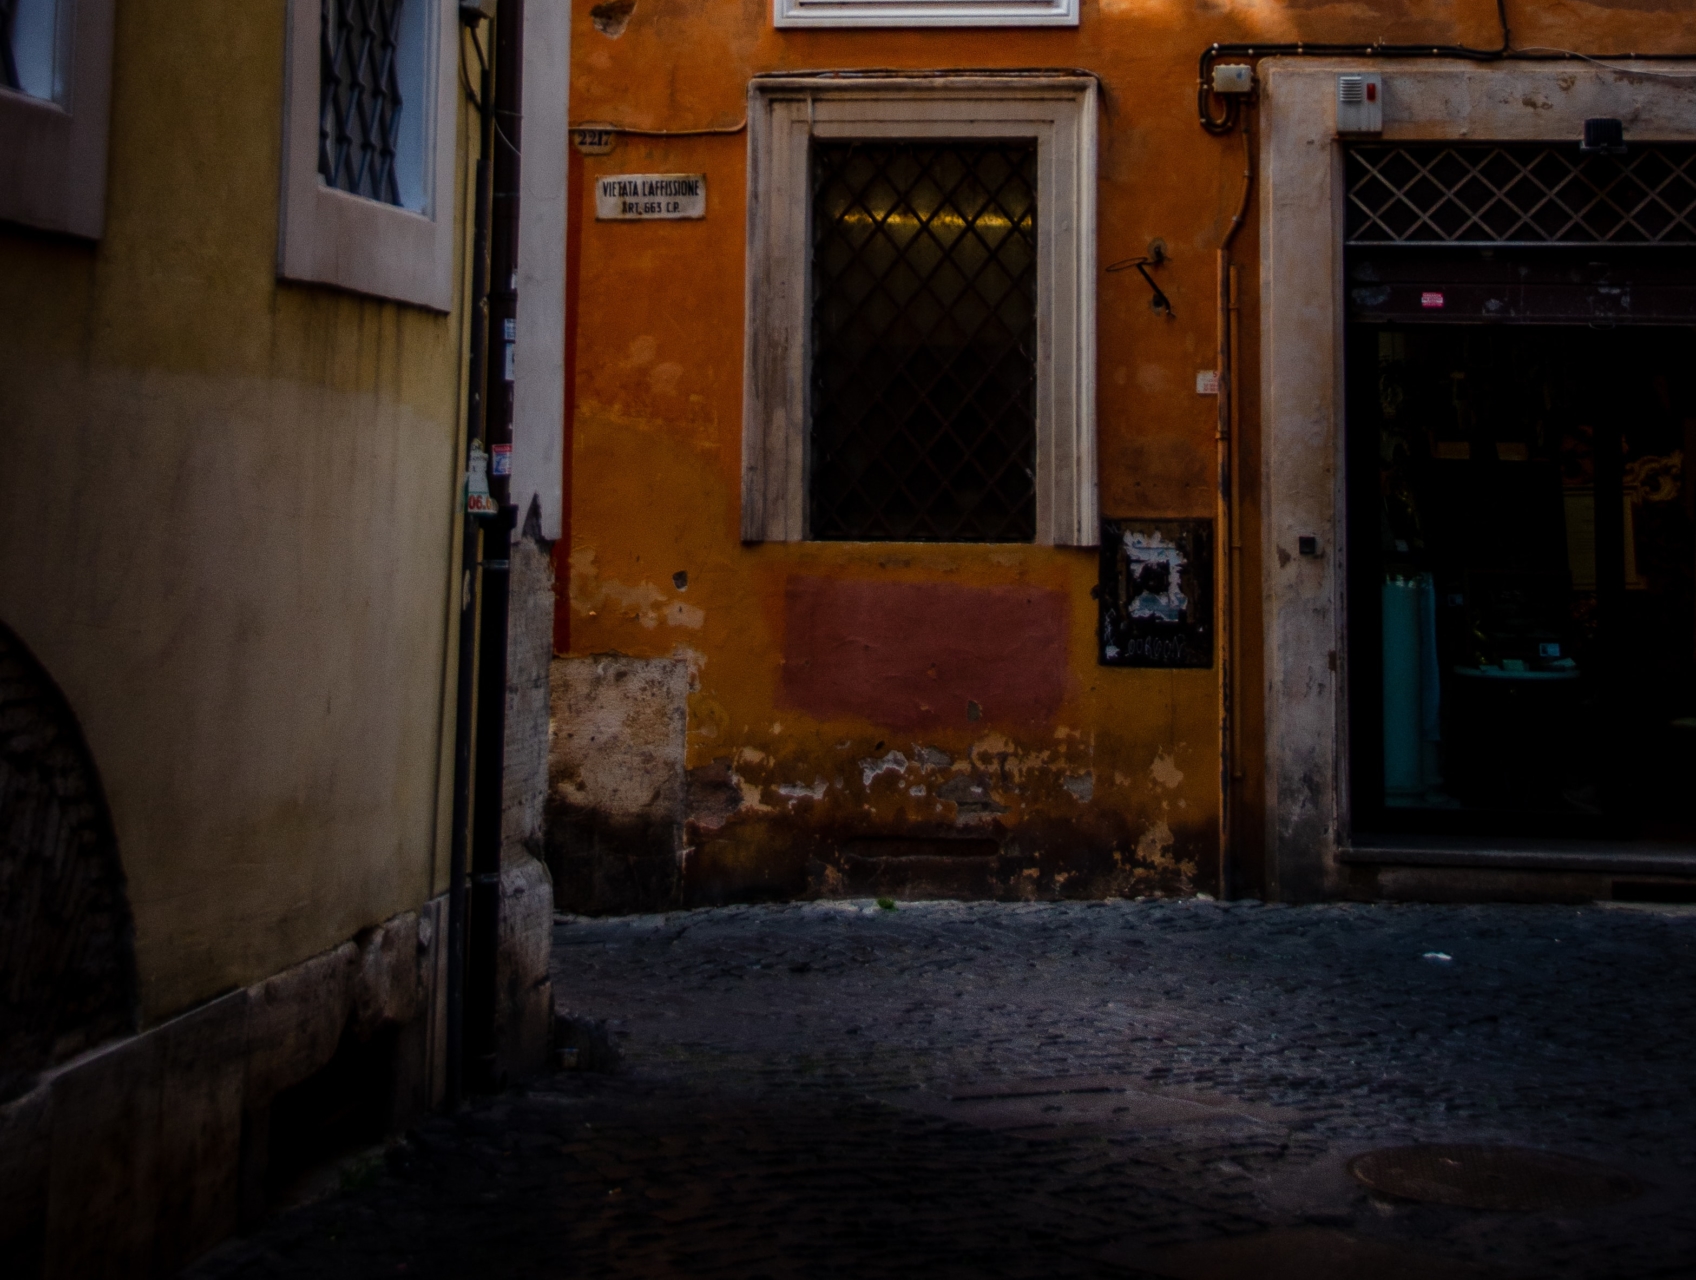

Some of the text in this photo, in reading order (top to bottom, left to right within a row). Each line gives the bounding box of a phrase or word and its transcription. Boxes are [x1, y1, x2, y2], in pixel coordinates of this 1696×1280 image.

[602, 180, 699, 197] VIETATA L'AFFISSIONE
[644, 202, 662, 214] 663
